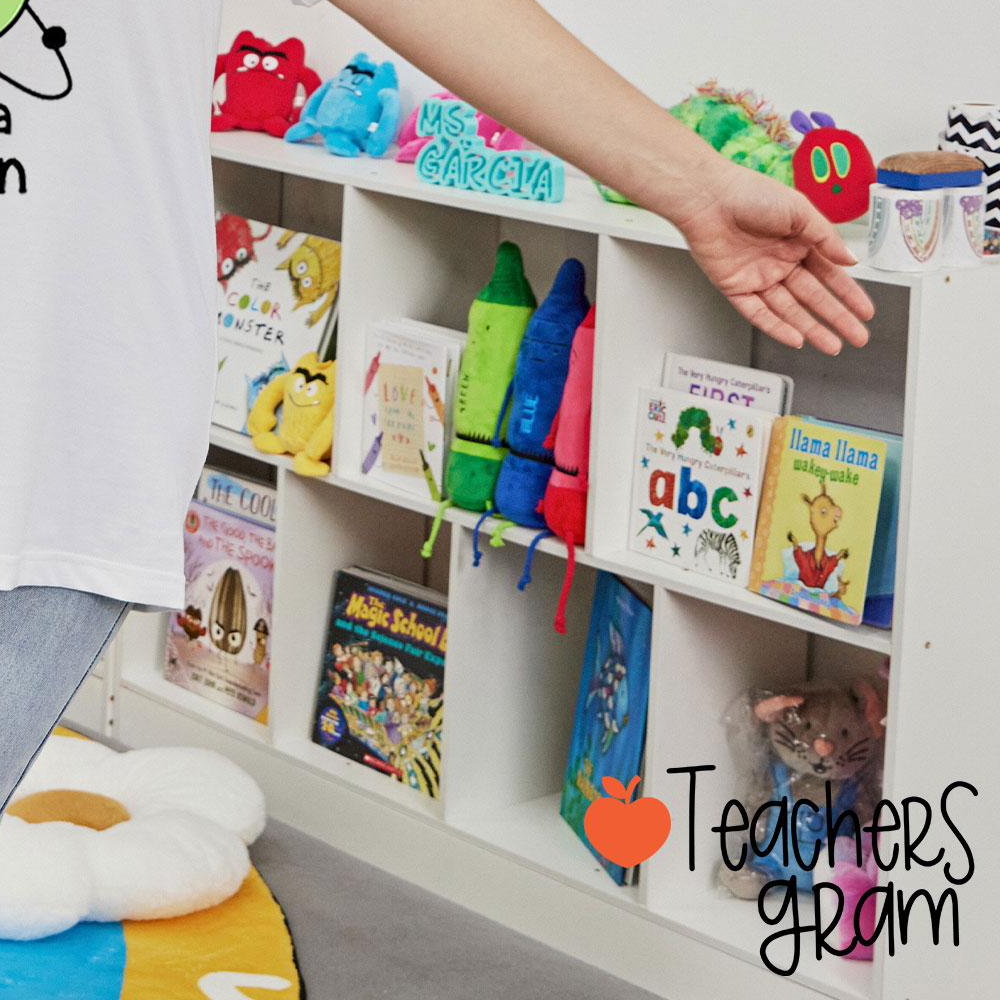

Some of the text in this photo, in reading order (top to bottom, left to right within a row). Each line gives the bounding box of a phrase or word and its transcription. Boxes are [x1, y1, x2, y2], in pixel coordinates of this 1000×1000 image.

[417, 145, 553, 201] GARCIA
[227, 291, 281, 320] COLOR
[705, 374, 728, 386] Hungry
[789, 428, 878, 470] llama llama
[793, 457, 859, 486] wakey-wake
[211, 478, 233, 505] THE
[648, 466, 739, 529] abc
[346, 592, 390, 628] Magic
[390, 607, 441, 647] School
